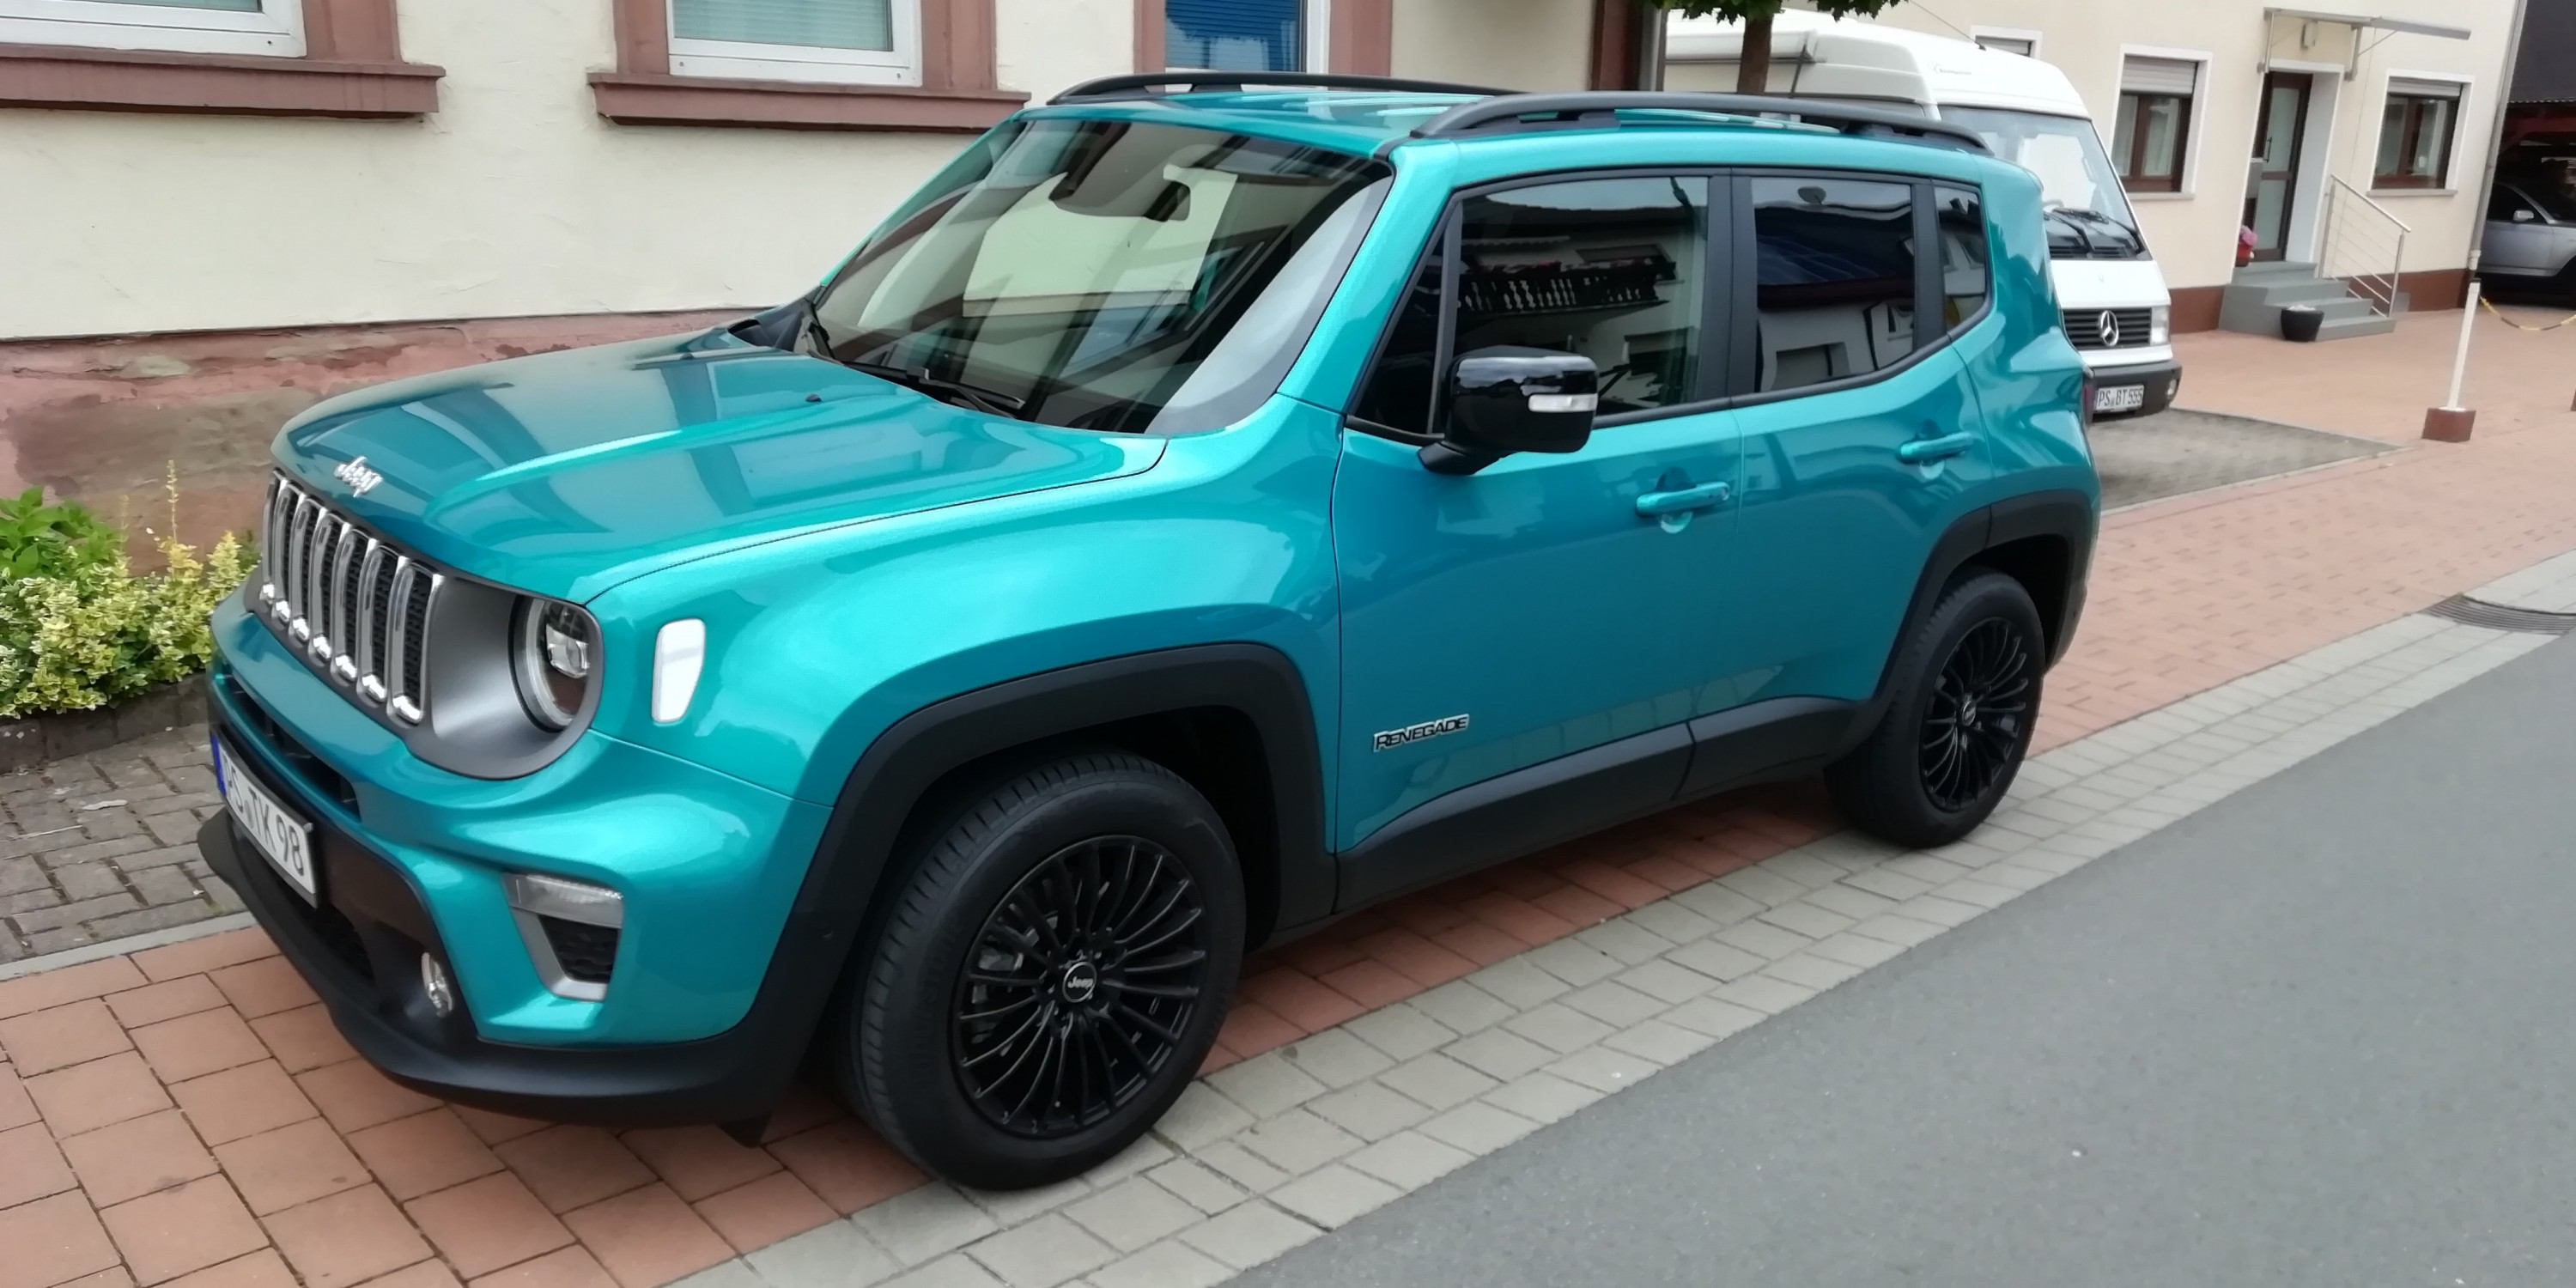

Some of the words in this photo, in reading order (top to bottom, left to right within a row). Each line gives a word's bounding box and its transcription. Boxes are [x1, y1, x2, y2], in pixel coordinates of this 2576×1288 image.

[2098, 390, 2111, 407] PS
[2115, 388, 2128, 406] BT
[2127, 387, 2143, 404] 555
[333, 455, 384, 498] Jeep
[1373, 714, 1469, 752] RENEGADE
[247, 786, 276, 853] TK
[276, 813, 305, 877] 98
[1066, 975, 1094, 990] Jeep
